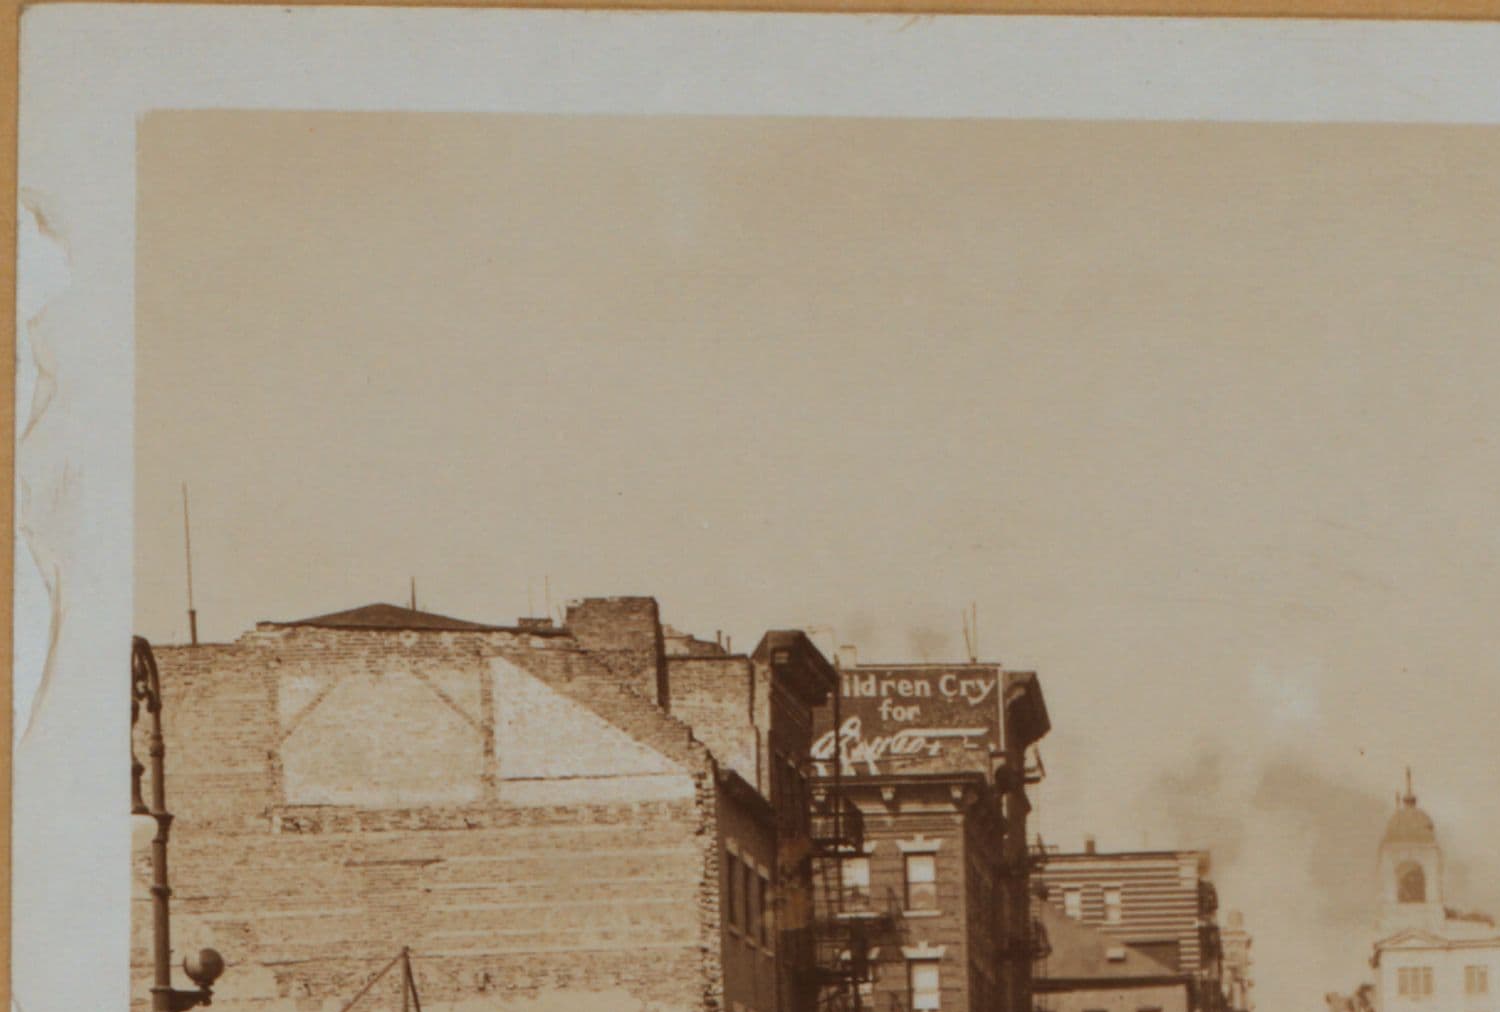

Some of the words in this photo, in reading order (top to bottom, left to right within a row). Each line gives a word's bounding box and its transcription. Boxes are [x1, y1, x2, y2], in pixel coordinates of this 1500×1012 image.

[842, 673, 931, 697] ildren
[938, 674, 996, 706] Cry
[878, 699, 920, 721] for
